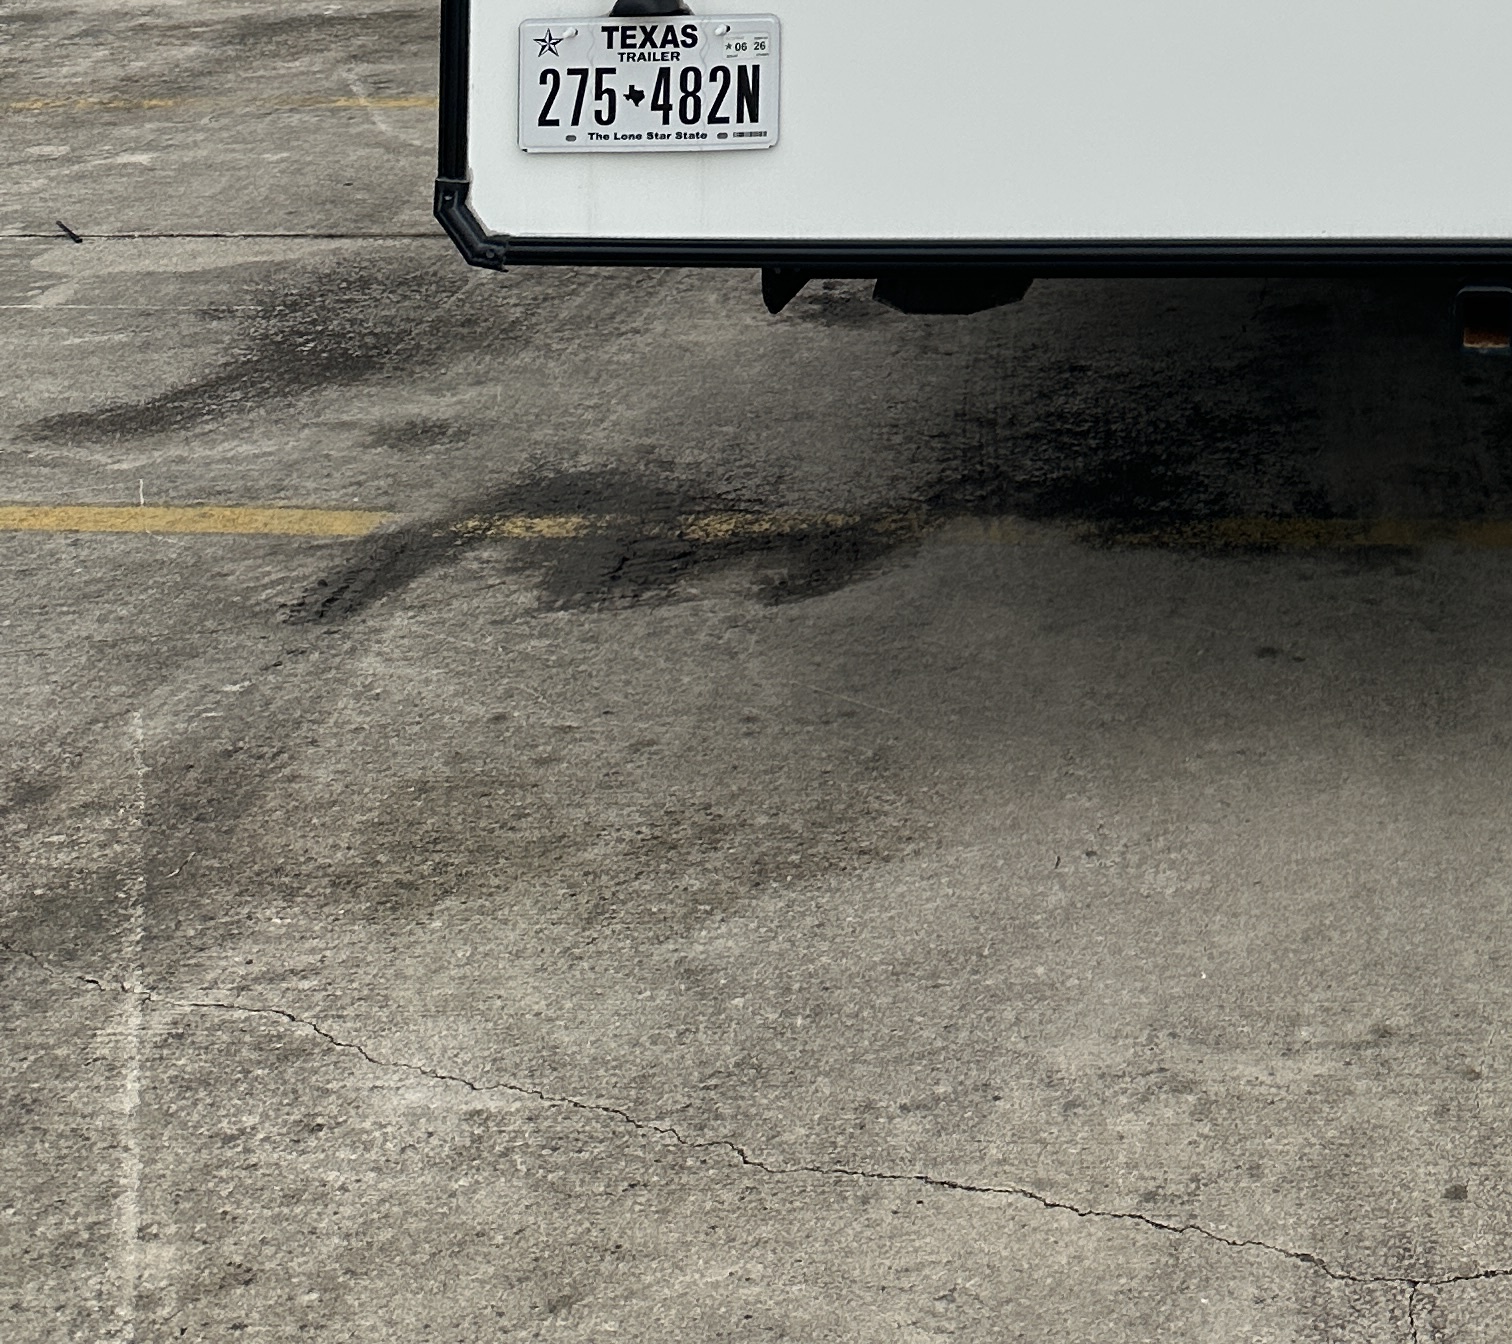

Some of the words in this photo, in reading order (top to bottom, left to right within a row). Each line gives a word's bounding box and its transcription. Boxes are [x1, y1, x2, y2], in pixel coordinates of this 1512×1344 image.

[601, 24, 699, 50] TEXAS
[734, 42, 748, 52] 06
[753, 41, 766, 51] 26
[617, 51, 681, 62] TRAILER
[588, 132, 610, 141] The
[613, 132, 643, 141] Lone
[646, 131, 672, 140] Star
[674, 131, 708, 140] State
